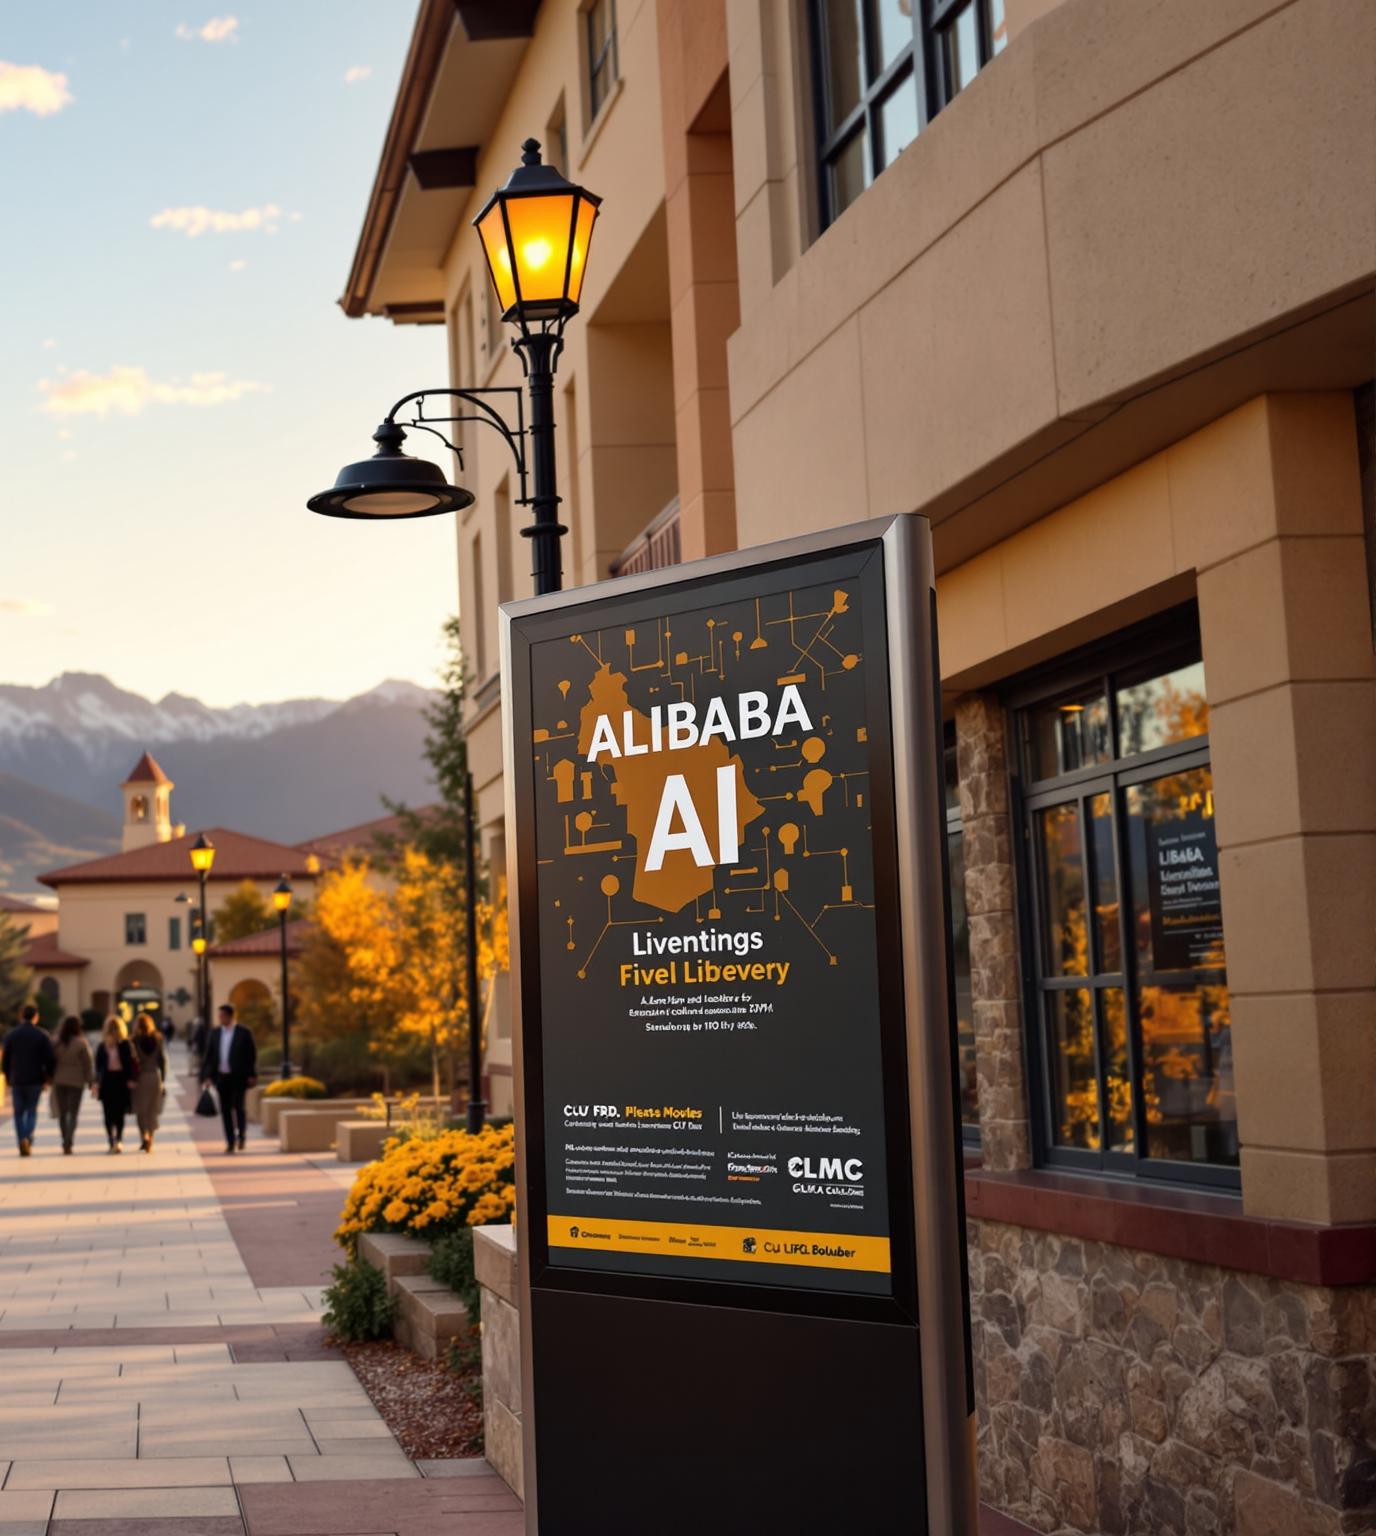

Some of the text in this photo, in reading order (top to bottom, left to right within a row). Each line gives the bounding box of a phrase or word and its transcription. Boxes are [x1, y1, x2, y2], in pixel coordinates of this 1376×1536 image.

[586, 684, 814, 763] ALIBABA
[644, 764, 740, 872] AI
[632, 928, 764, 956] Liventings
[620, 959, 790, 987] Fivel Libevery
[787, 1156, 864, 1181] CLMC
